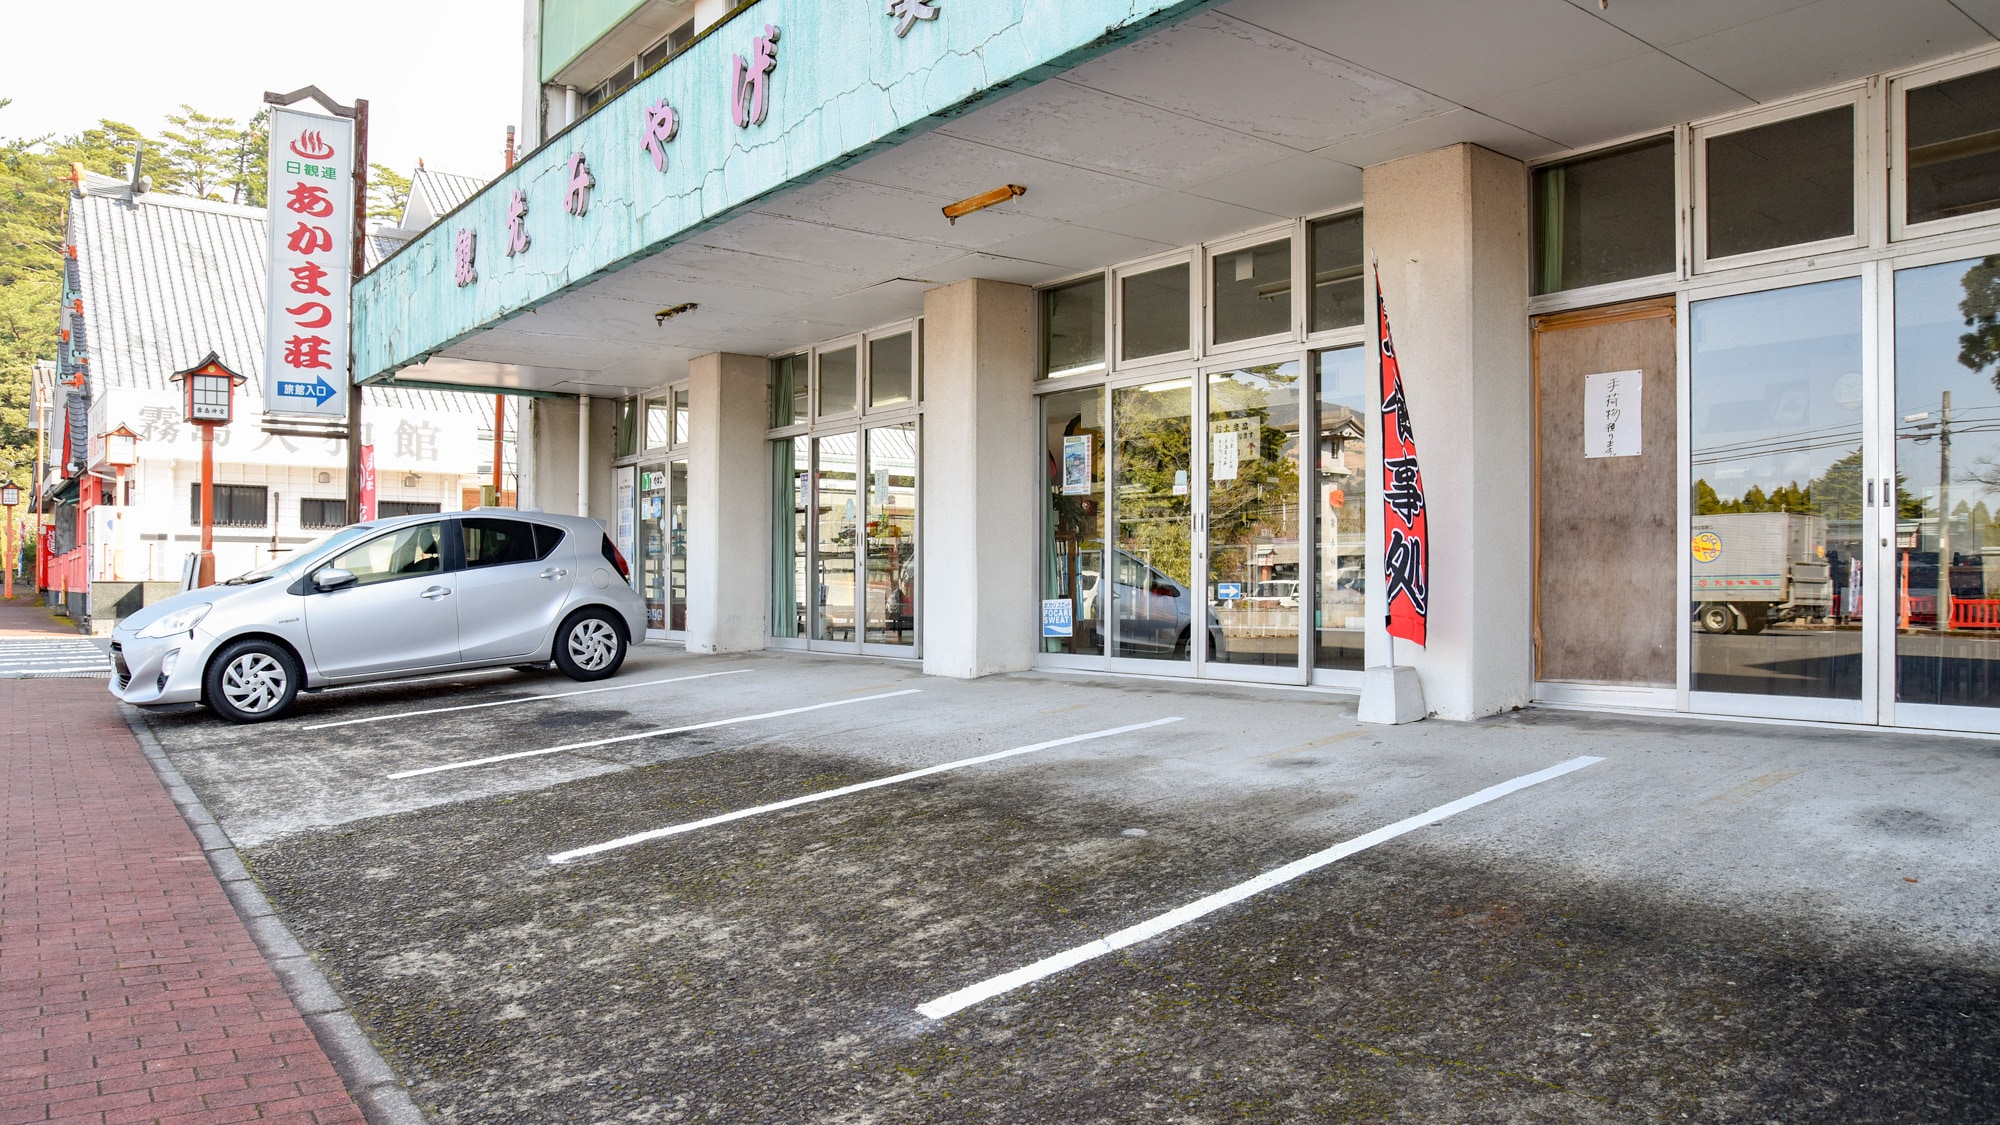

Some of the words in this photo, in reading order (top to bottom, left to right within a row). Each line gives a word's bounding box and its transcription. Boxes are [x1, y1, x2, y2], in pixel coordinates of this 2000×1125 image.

[454, 23, 782, 289] 観光みやげ
[286, 160, 337, 181] 日観連
[284, 181, 334, 371] あかまつ荘
[283, 383, 327, 398] 旅館入口
[1043, 609, 1071, 617] POCARI
[1043, 616, 1069, 624] SWEAT
